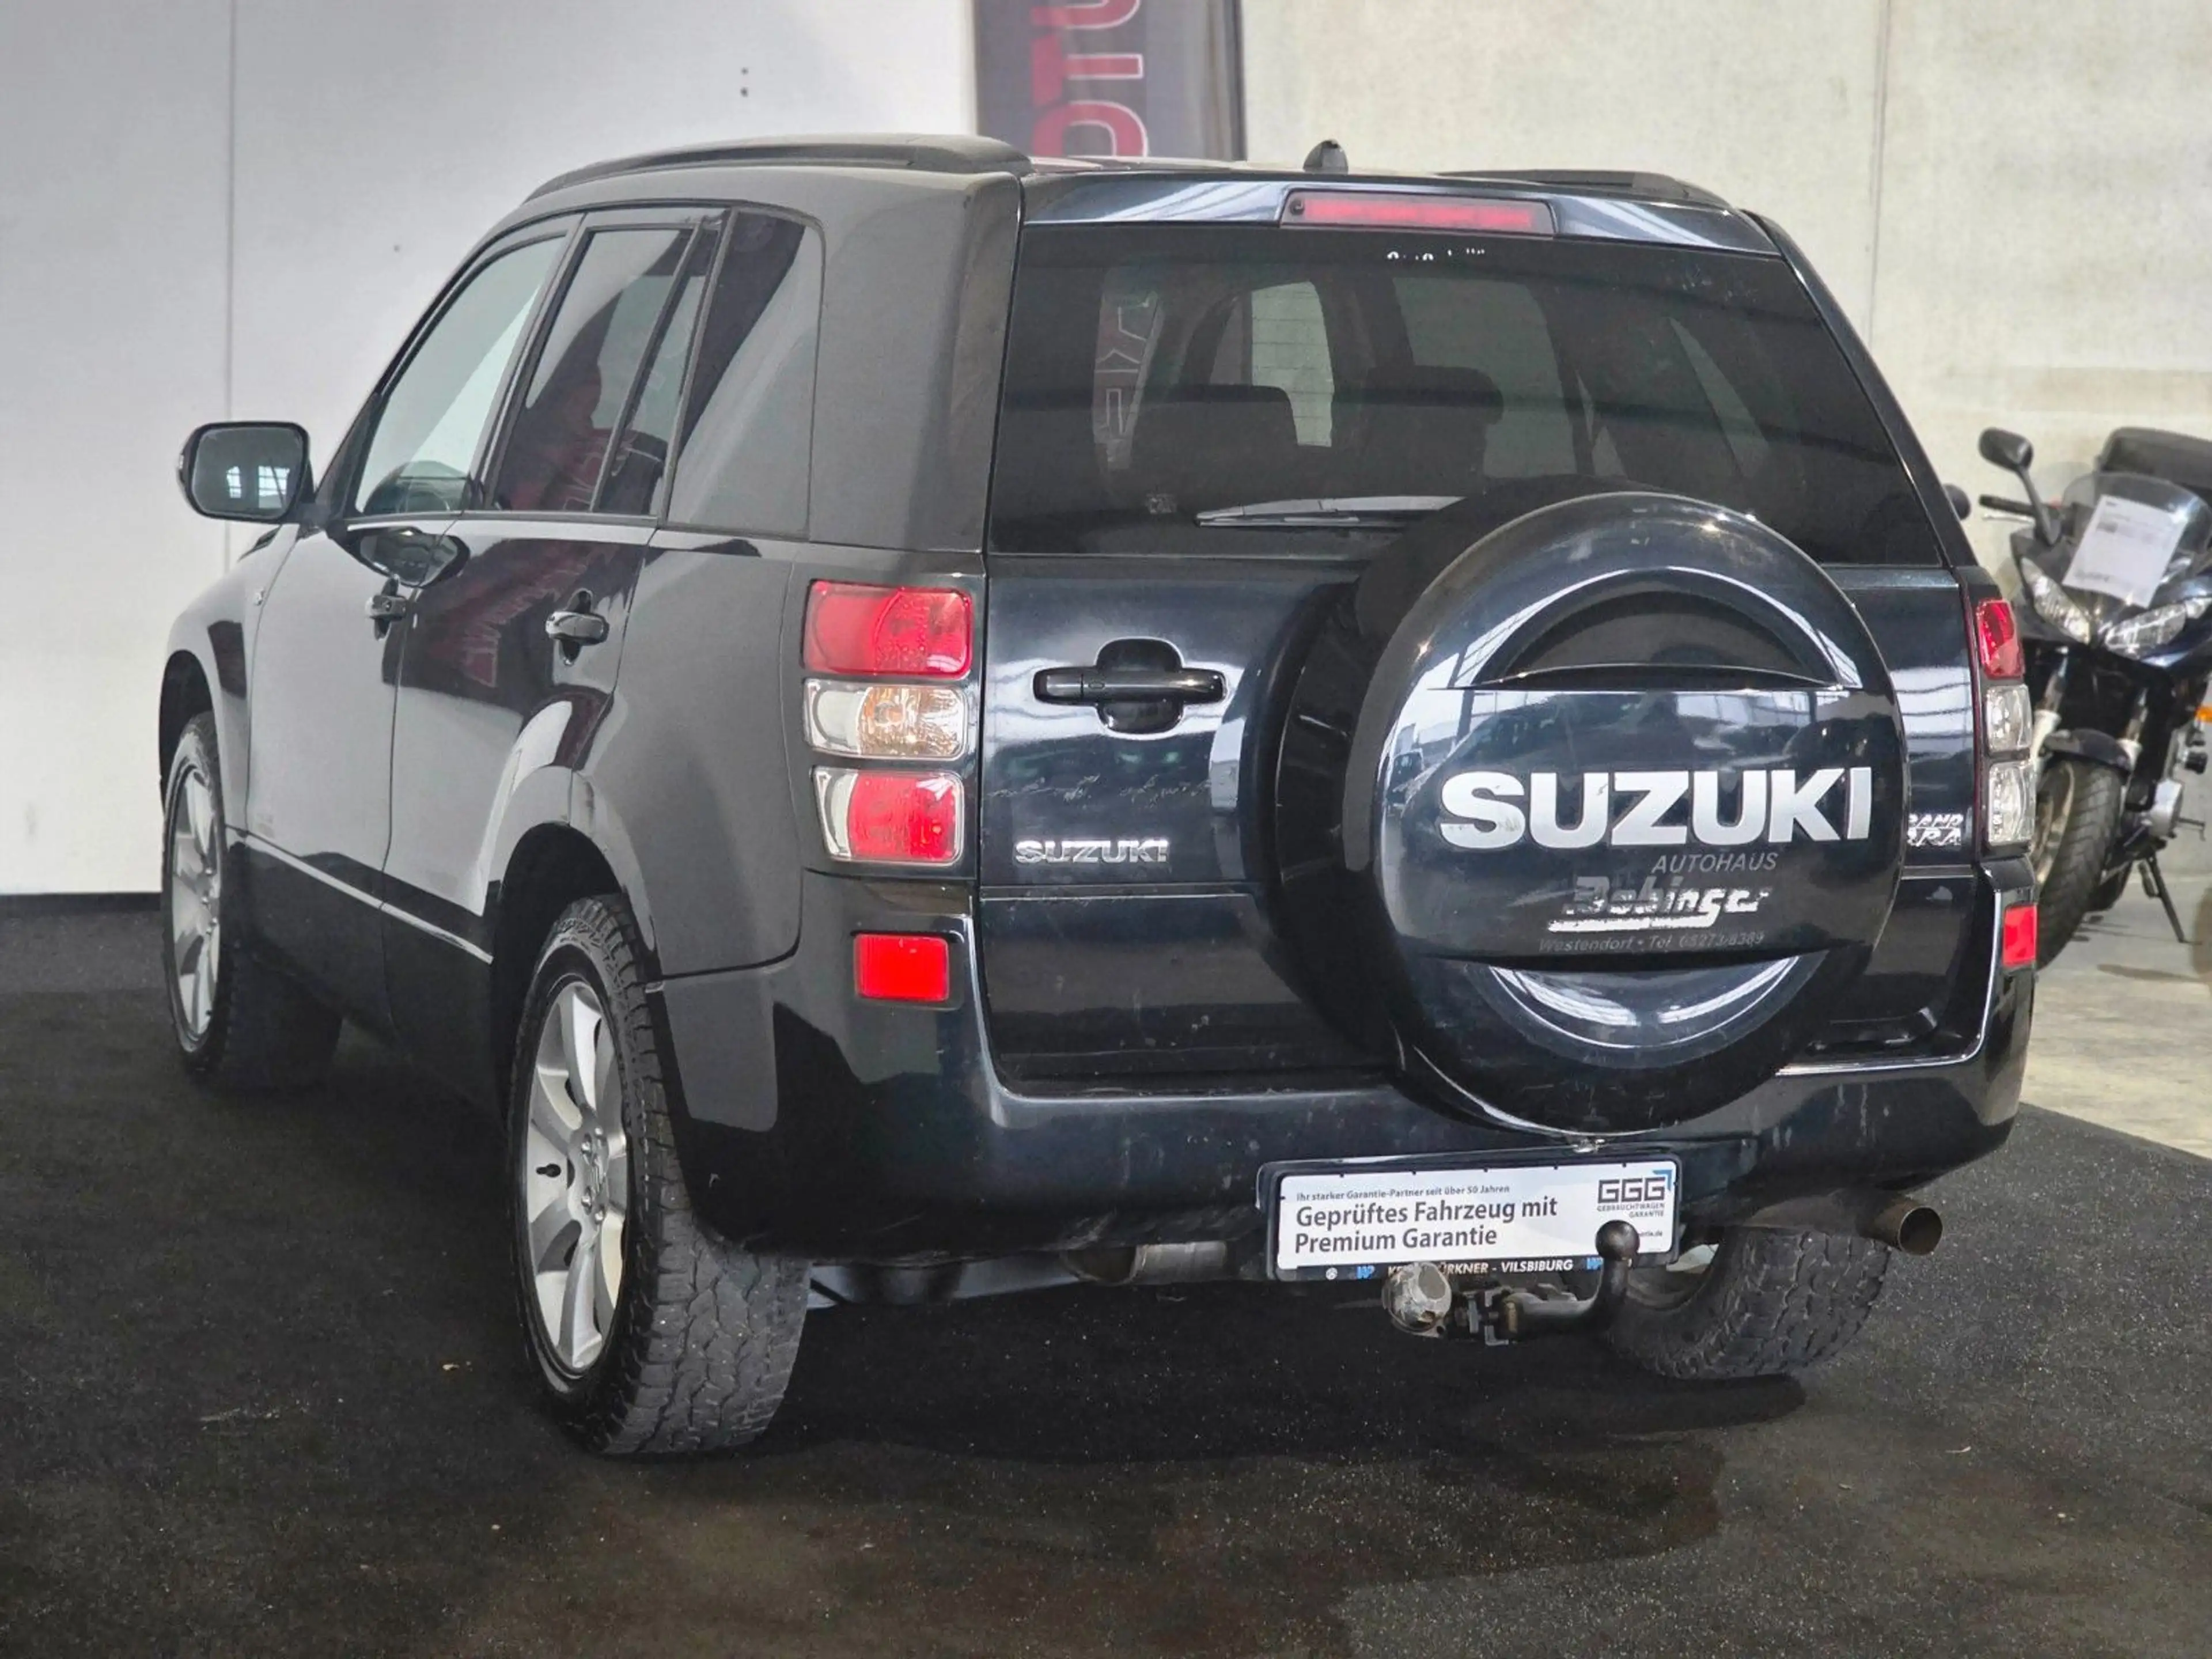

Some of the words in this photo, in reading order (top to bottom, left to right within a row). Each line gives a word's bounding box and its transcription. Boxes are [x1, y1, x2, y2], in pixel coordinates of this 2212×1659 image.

[1441, 767, 1872, 849] SUZUKI
[1015, 839, 1169, 863] SUZUKI
[1652, 852, 1778, 874] AUTOHAUS
[1312, 1191, 1344, 1201] starker
[1346, 1188, 1423, 1200] Garantie-Partner
[1425, 1187, 1442, 1196] seit
[1444, 1185, 1465, 1196] über
[1468, 1185, 1479, 1194] 50
[1480, 1184, 1510, 1194] Jahren
[1597, 1176, 1666, 1203] GGG
[1296, 1202, 1408, 1232] Geprüftes
[1414, 1199, 1516, 1224] Fahrzeug
[1521, 1195, 1558, 1217] mit
[1628, 1210, 1664, 1218] GARANTIE
[1295, 1230, 1396, 1254] Premium
[1402, 1224, 1497, 1248] Garantie
[1500, 1259, 1574, 1273] VILSBIBURG
